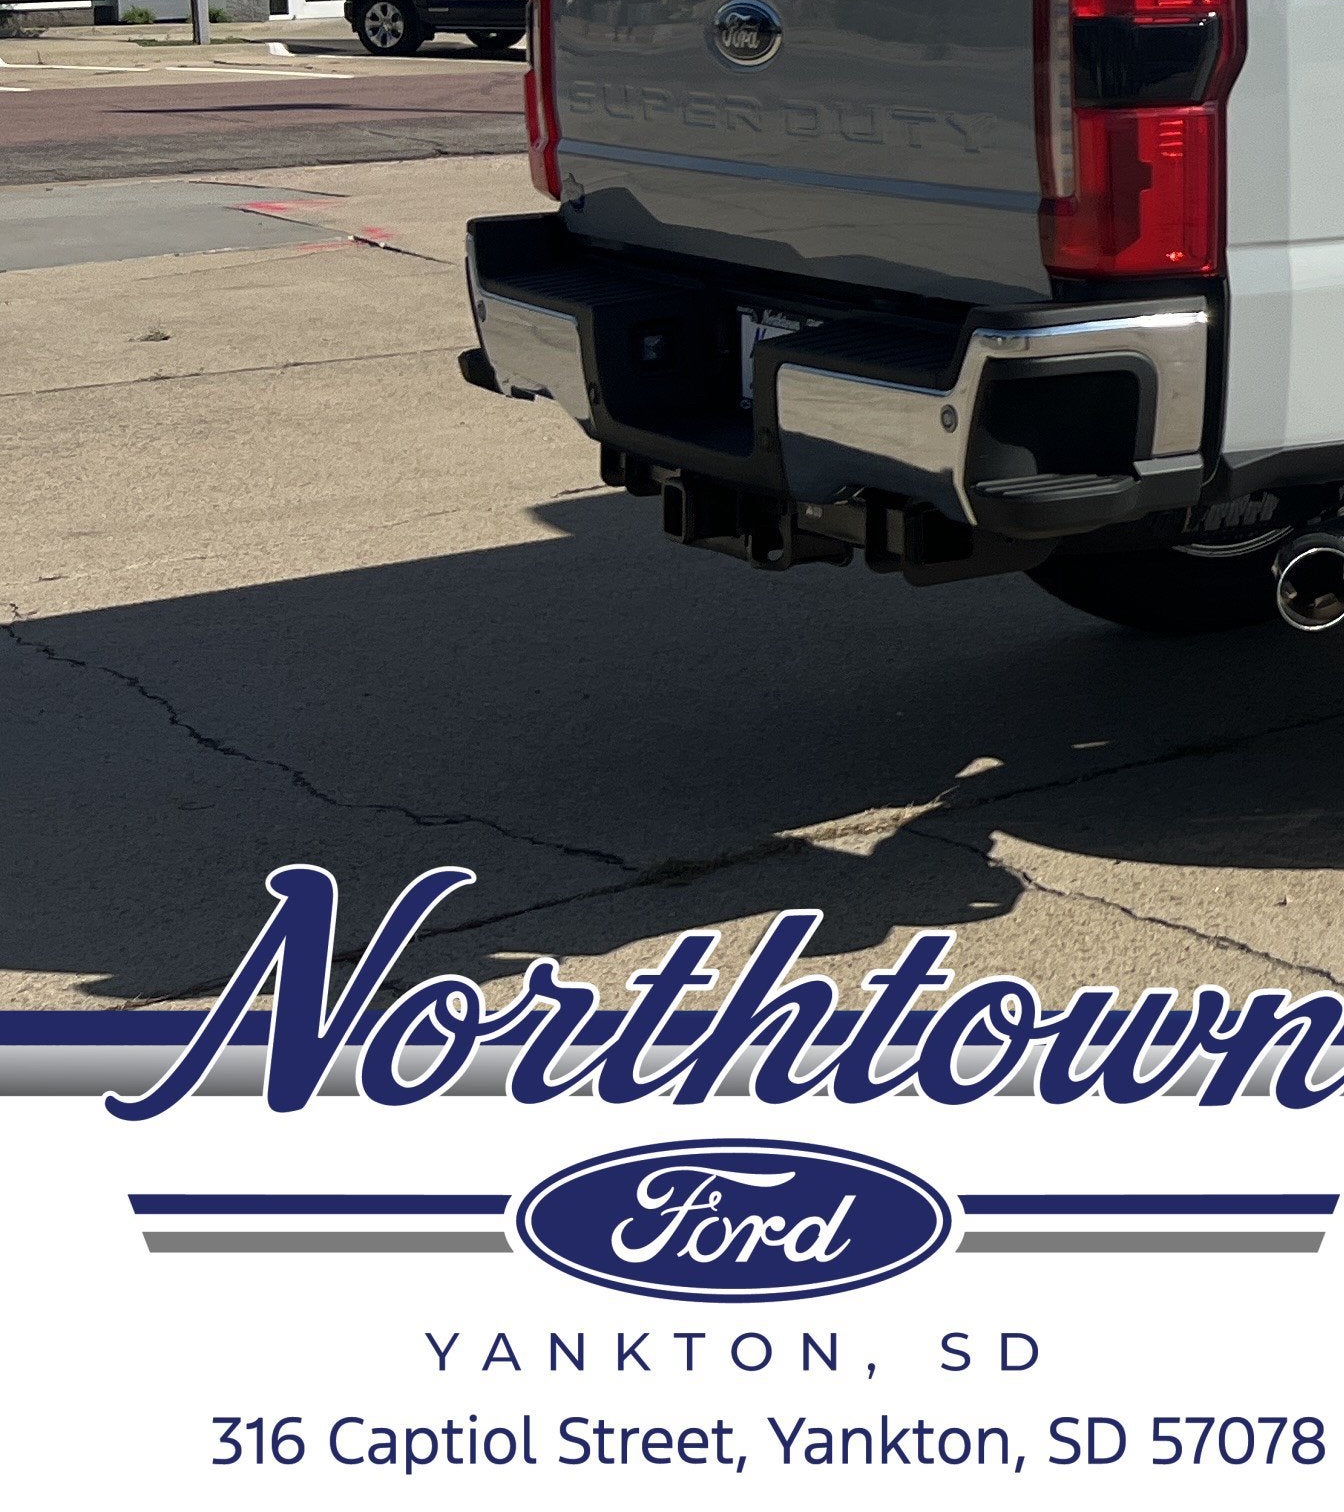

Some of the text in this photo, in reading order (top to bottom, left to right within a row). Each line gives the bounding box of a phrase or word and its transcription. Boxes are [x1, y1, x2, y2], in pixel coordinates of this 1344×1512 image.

[721, 11, 762, 50] Ford
[569, 79, 998, 155] SUPER DUTY
